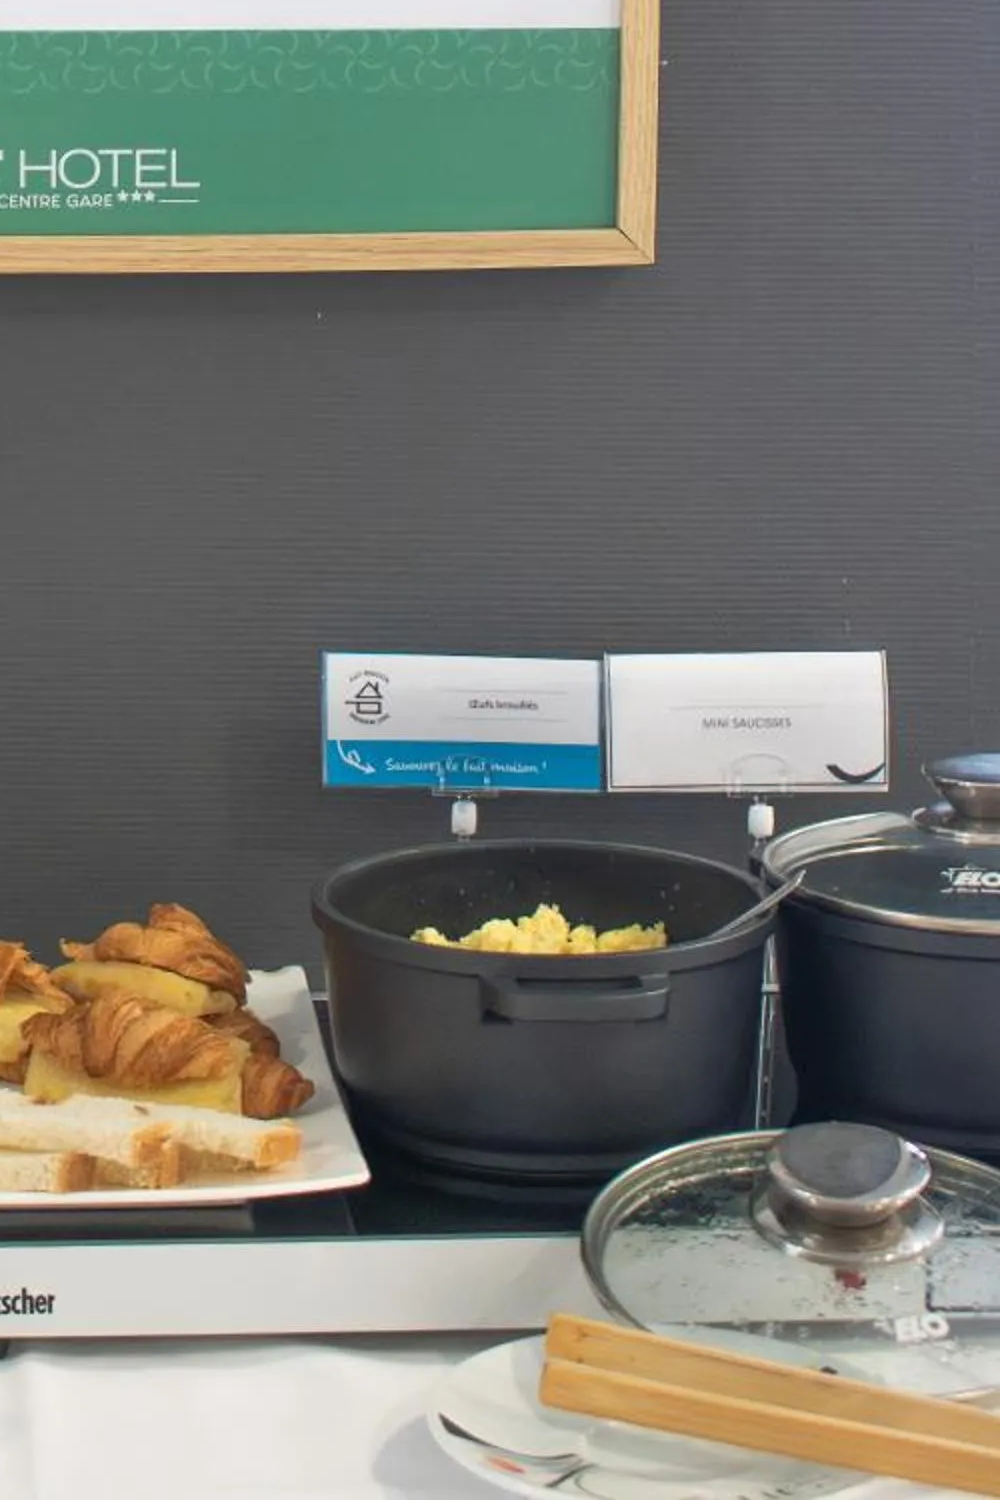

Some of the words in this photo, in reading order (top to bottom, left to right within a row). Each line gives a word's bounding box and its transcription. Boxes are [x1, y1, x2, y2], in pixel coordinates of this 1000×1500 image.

[20, 150, 200, 188] HOTEL
[66, 193, 113, 209] GARE
[701, 716, 730, 729] MINI
